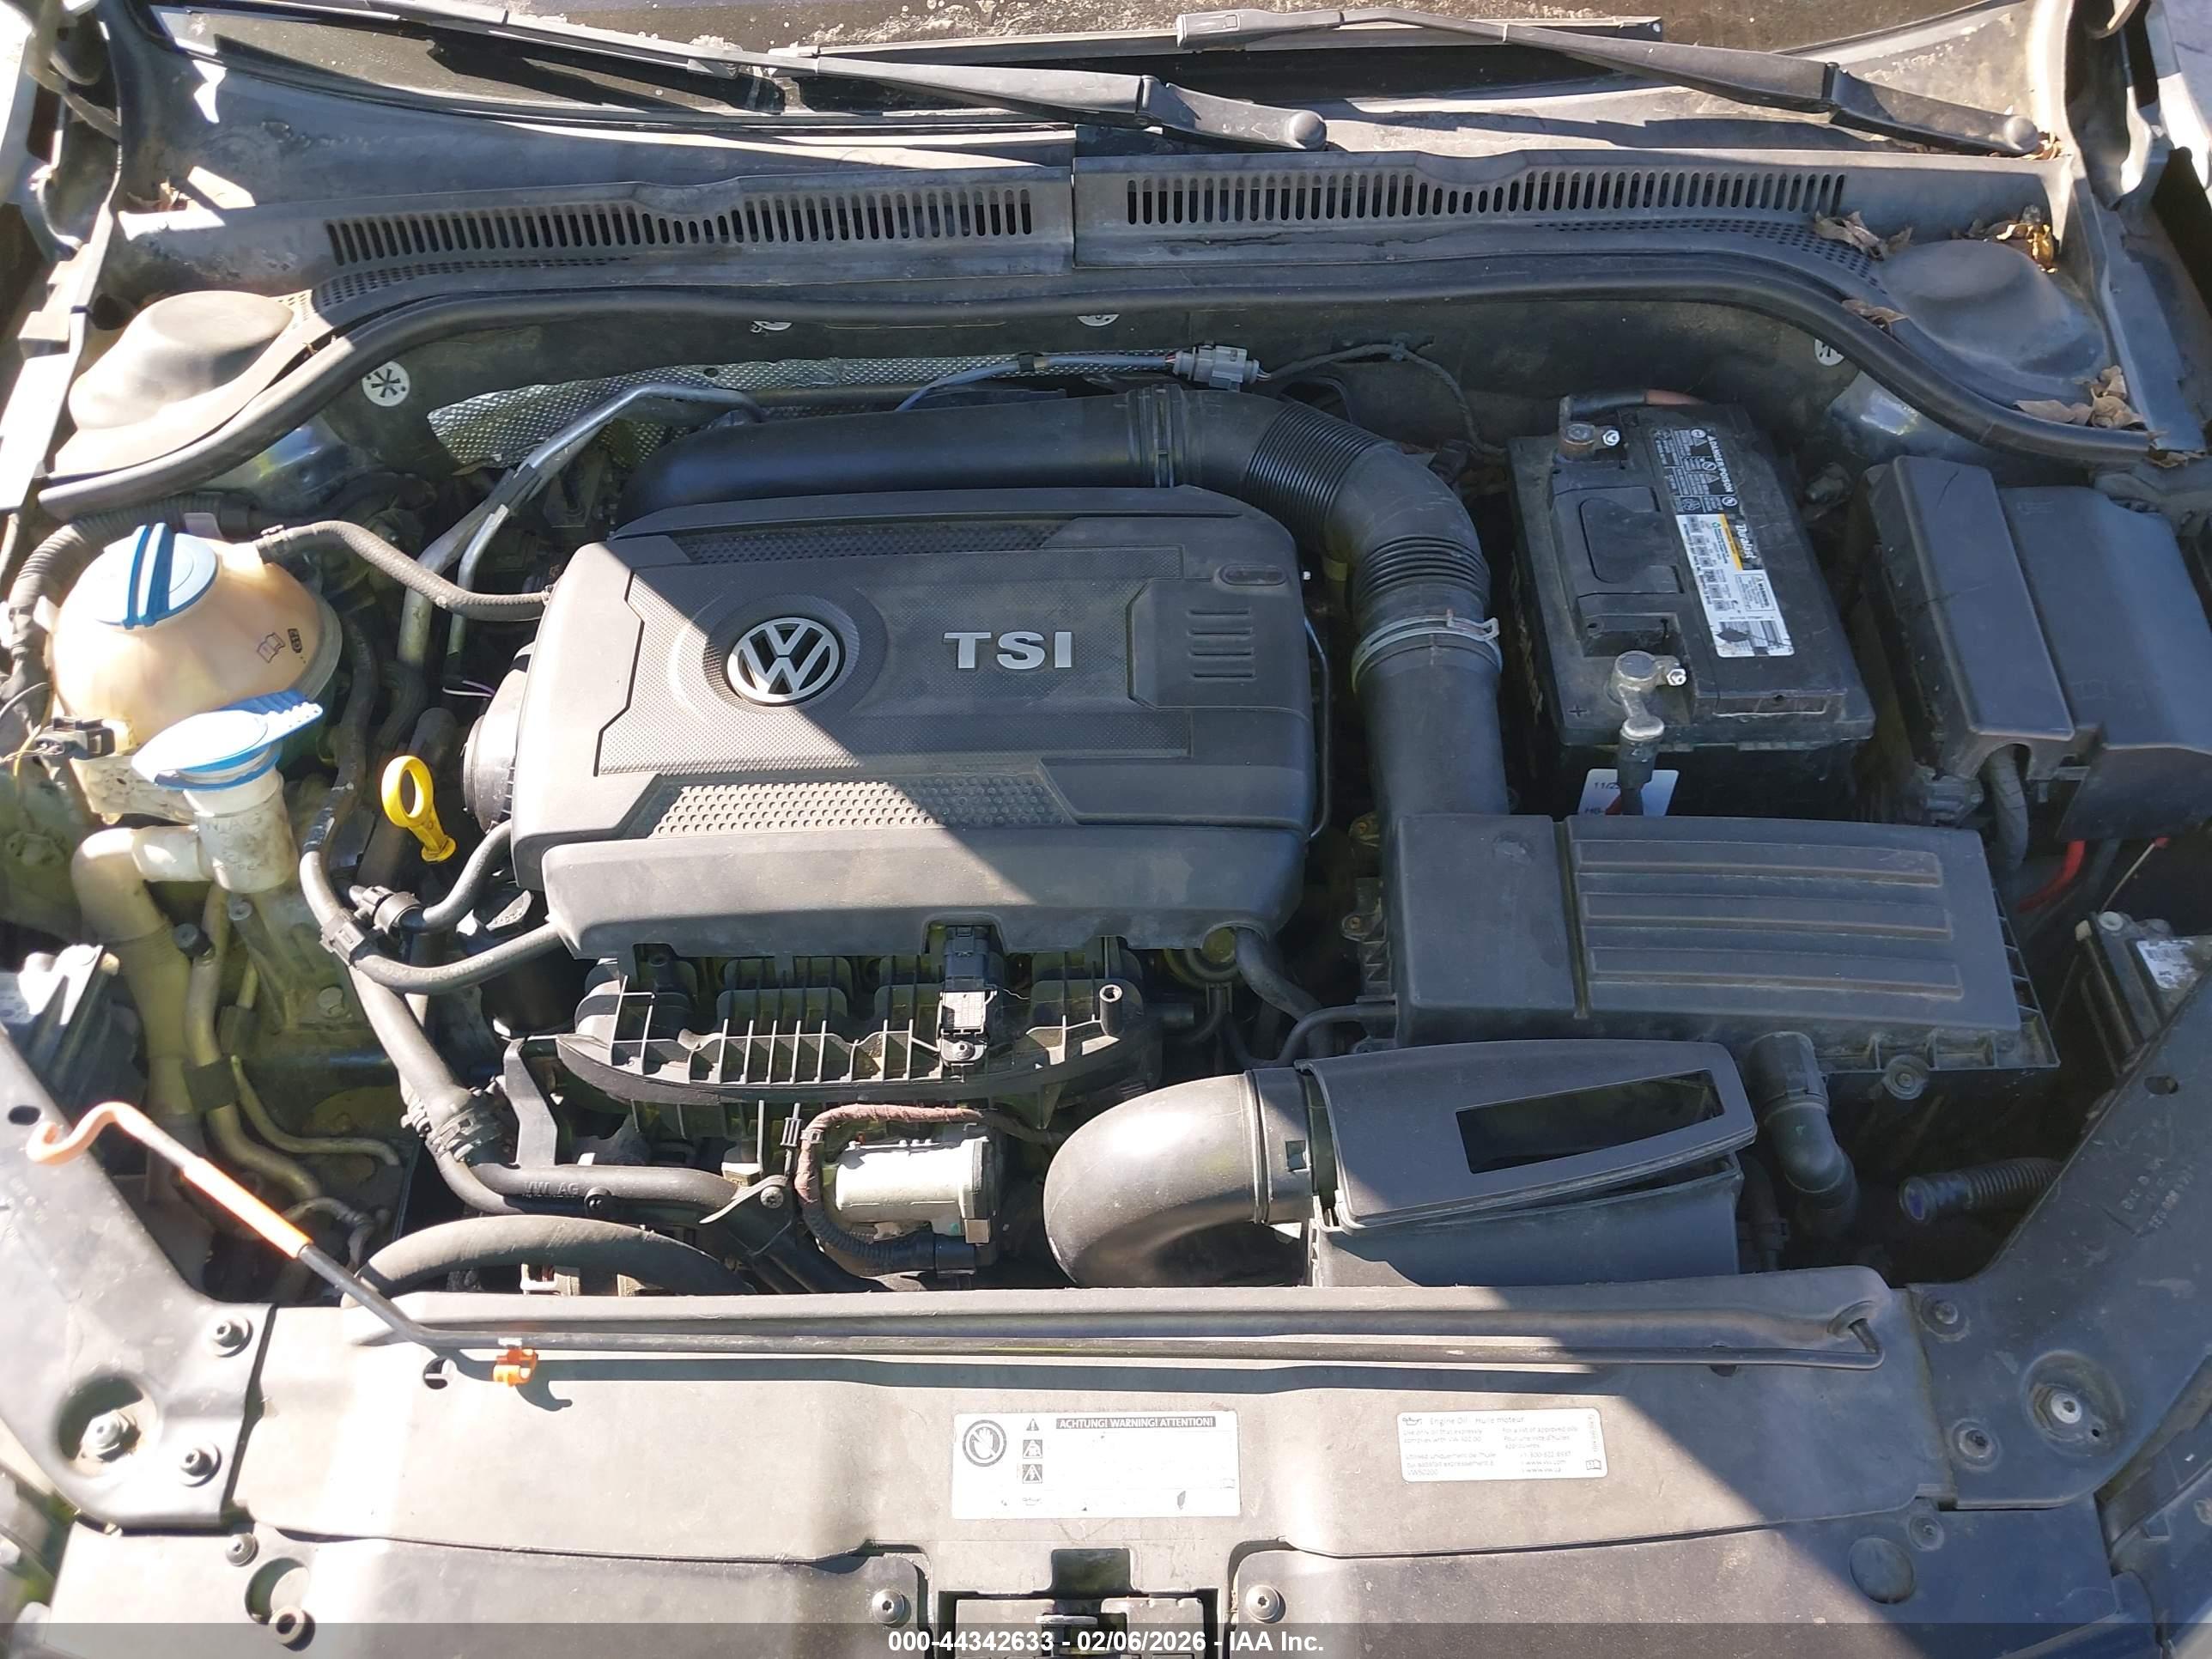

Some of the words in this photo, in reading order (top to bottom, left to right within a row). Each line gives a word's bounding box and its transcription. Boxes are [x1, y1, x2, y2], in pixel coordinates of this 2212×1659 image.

[727, 617, 841, 708] VW
[944, 631, 1073, 670] TSI
[557, 1182, 580, 1194] AG
[1060, 1419, 1109, 1429] ACHTUNG!
[1109, 1418, 1158, 1428] WARNING!
[1159, 1417, 1213, 1427] ATTENTION!
